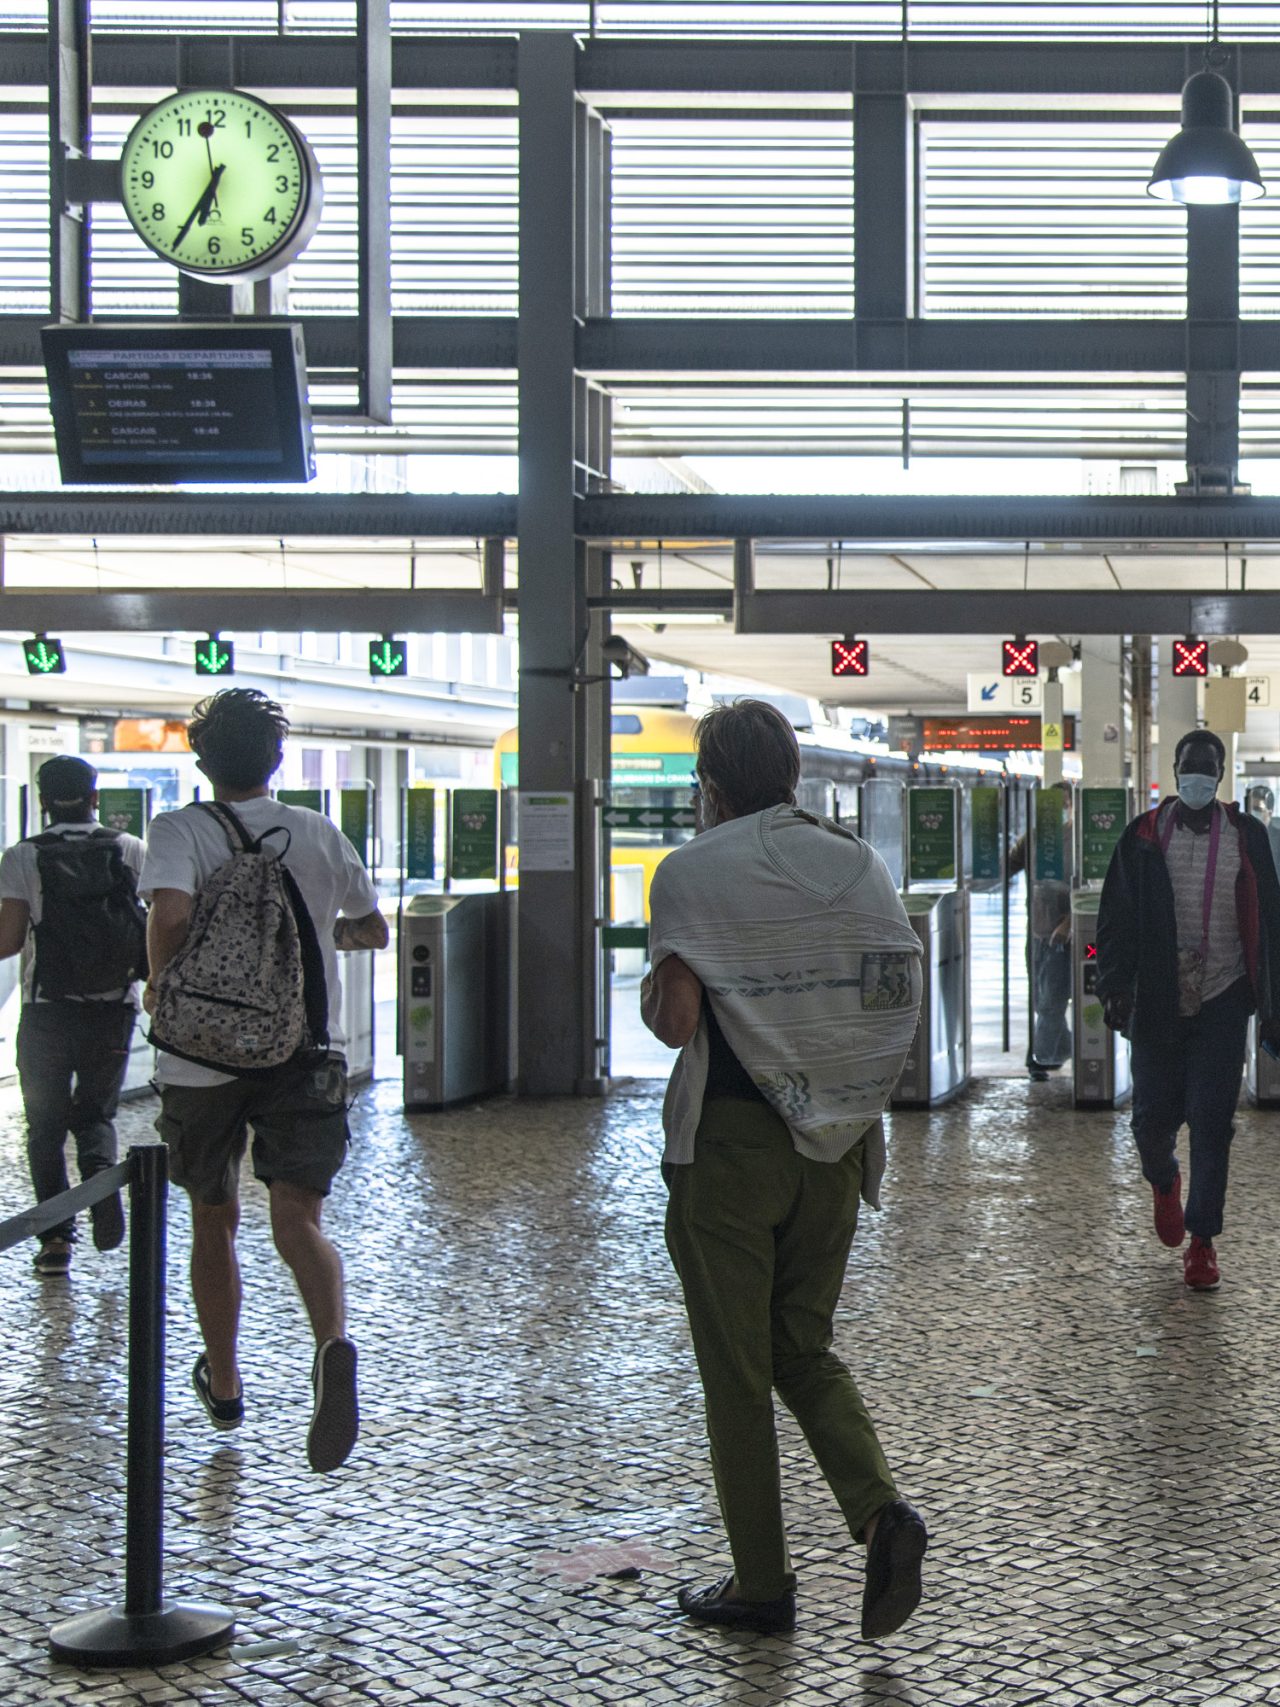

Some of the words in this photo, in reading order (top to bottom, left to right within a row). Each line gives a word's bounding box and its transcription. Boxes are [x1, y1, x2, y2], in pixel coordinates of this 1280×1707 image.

[177, 118, 191, 137] 11
[245, 120, 251, 139] 1
[152, 140, 174, 159] 10
[266, 144, 280, 163] 2
[141, 170, 155, 189] 9
[275, 175, 289, 194] 3
[151, 202, 165, 221] 8
[263, 206, 277, 225] 4
[207, 236, 221, 255] 6
[241, 227, 255, 247] 5
[113, 352, 169, 360] PARTIDAS
[179, 352, 255, 360] DEPARTURES
[104, 372, 150, 381] CASCAIS
[108, 400, 147, 408] OEIRAS
[111, 427, 157, 436] CASCAIS
[1021, 687, 1032, 704] 5
[1248, 686, 1260, 703] 4
